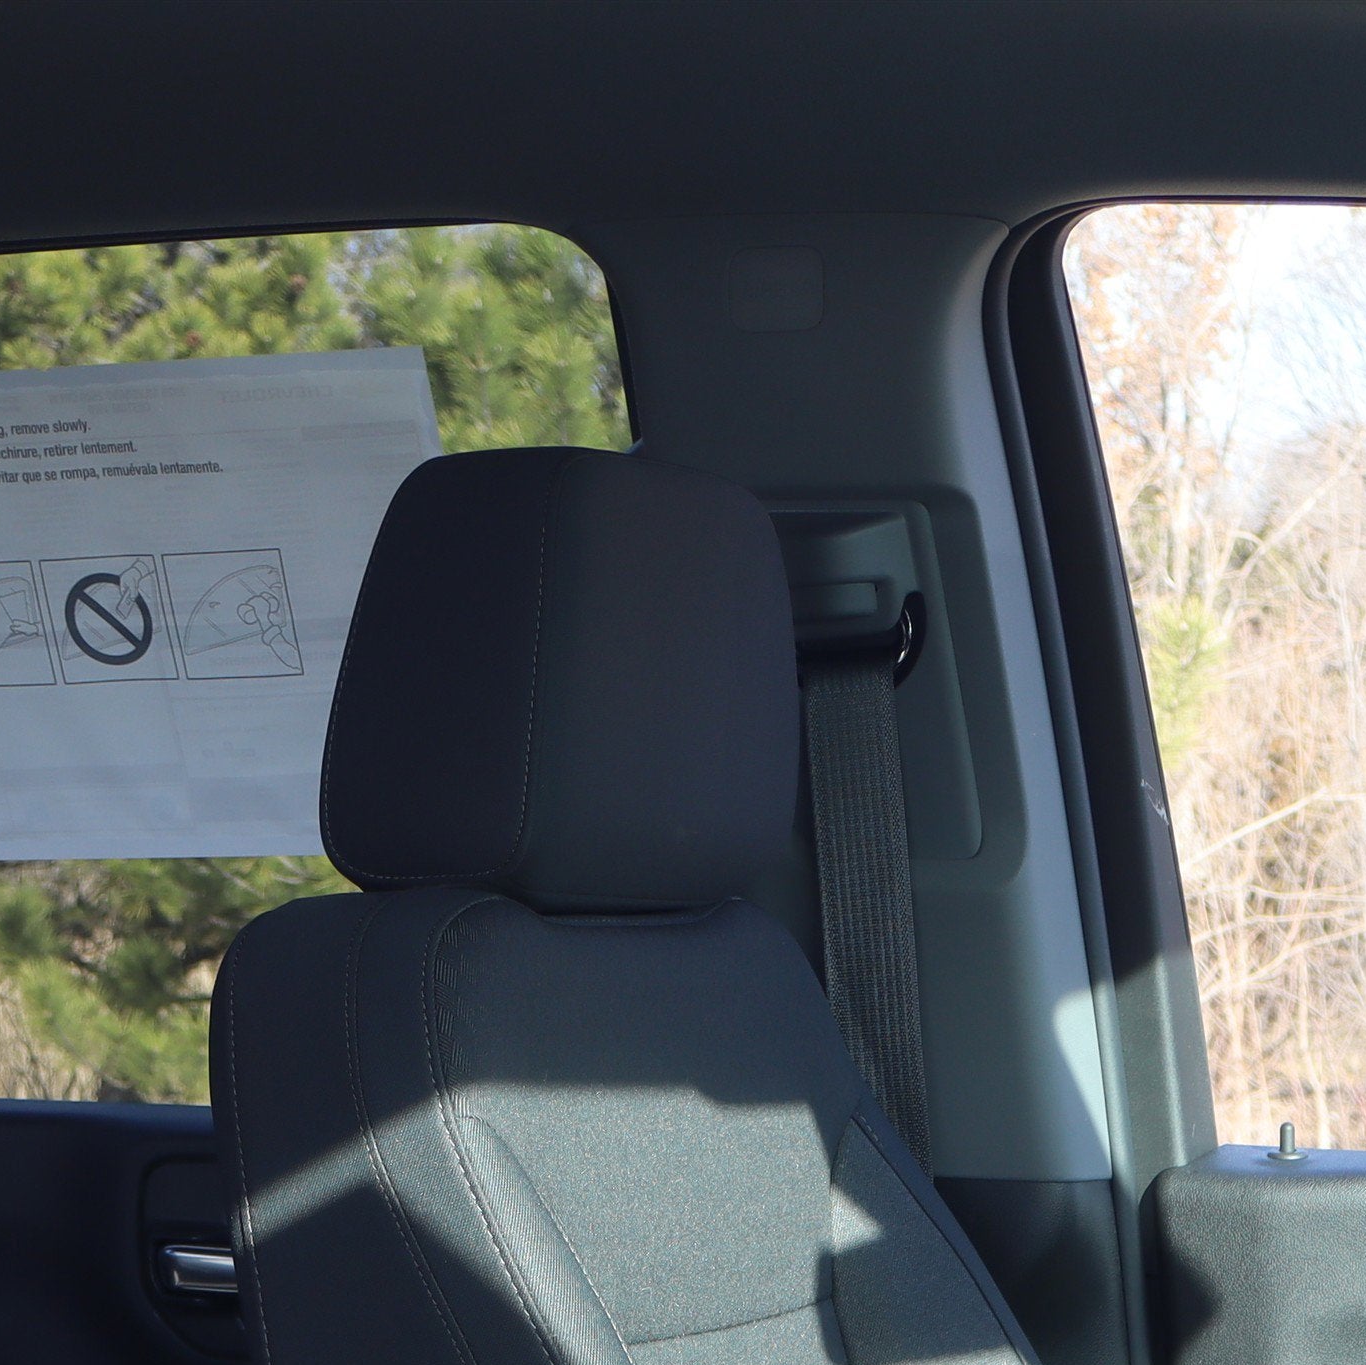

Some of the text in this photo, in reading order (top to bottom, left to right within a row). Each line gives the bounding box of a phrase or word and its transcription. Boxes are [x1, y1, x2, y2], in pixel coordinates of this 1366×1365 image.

[10, 423, 50, 436] remove
[52, 418, 91, 434] slowly.
[43, 443, 79, 458] retirer
[80, 440, 138, 456] lentement.
[21, 471, 42, 485] que
[44, 470, 58, 482] se
[59, 467, 100, 482] rompa,
[101, 462, 159, 478] remuévala
[159, 460, 224, 475] lentamente.
